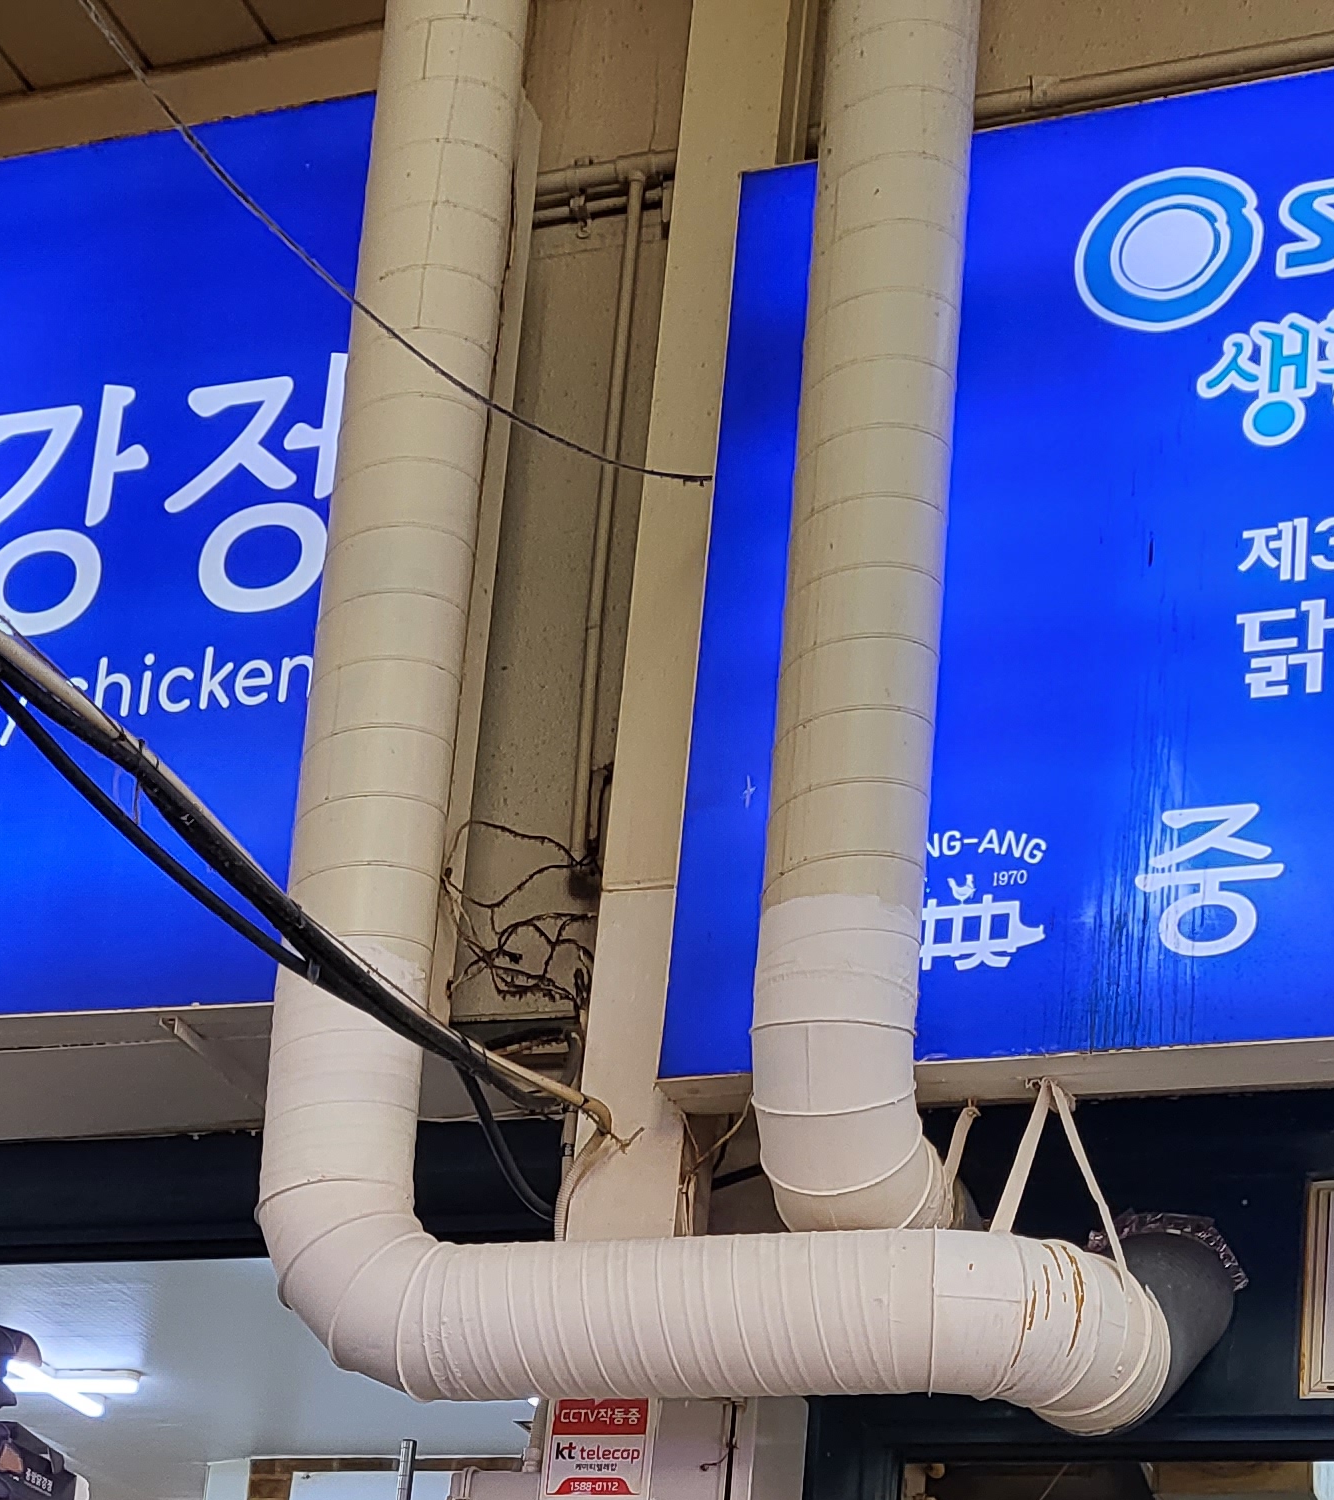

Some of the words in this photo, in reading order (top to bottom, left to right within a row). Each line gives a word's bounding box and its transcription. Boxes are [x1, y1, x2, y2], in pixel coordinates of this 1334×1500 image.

[993, 870, 1027, 886] 1970
[560, 1407, 641, 1425] CCTV작동중
[555, 1442, 576, 1460] kt
[580, 1444, 640, 1464] telecop
